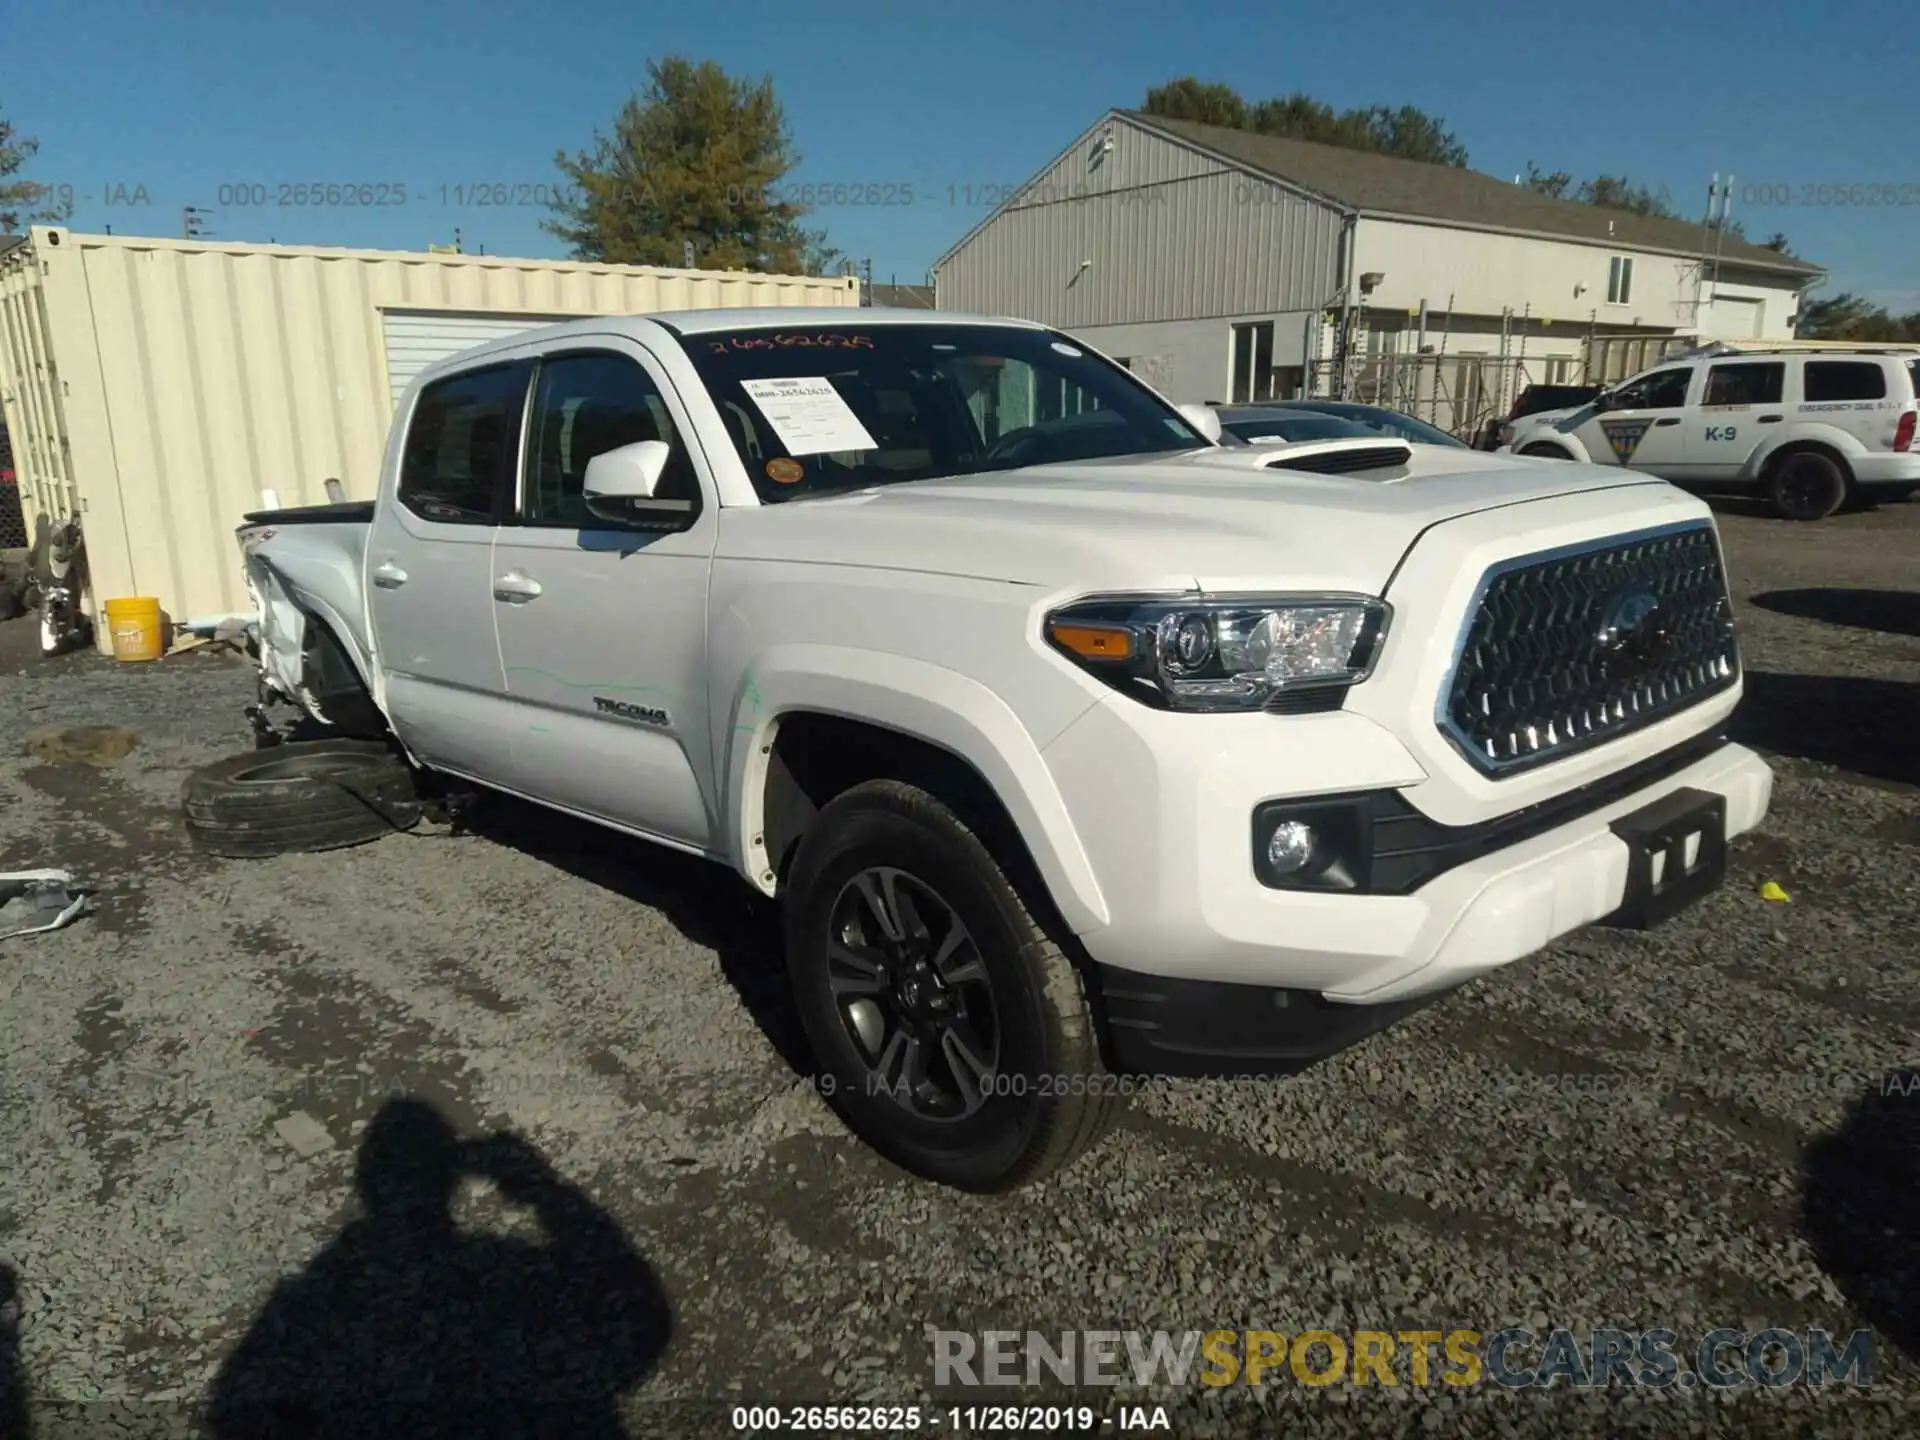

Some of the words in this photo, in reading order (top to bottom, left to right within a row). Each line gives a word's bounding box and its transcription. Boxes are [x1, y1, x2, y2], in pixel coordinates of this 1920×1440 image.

[1608, 428, 1641, 436] POLICE
[1705, 426, 1737, 441] K-9
[593, 696, 669, 726] TACOMA
